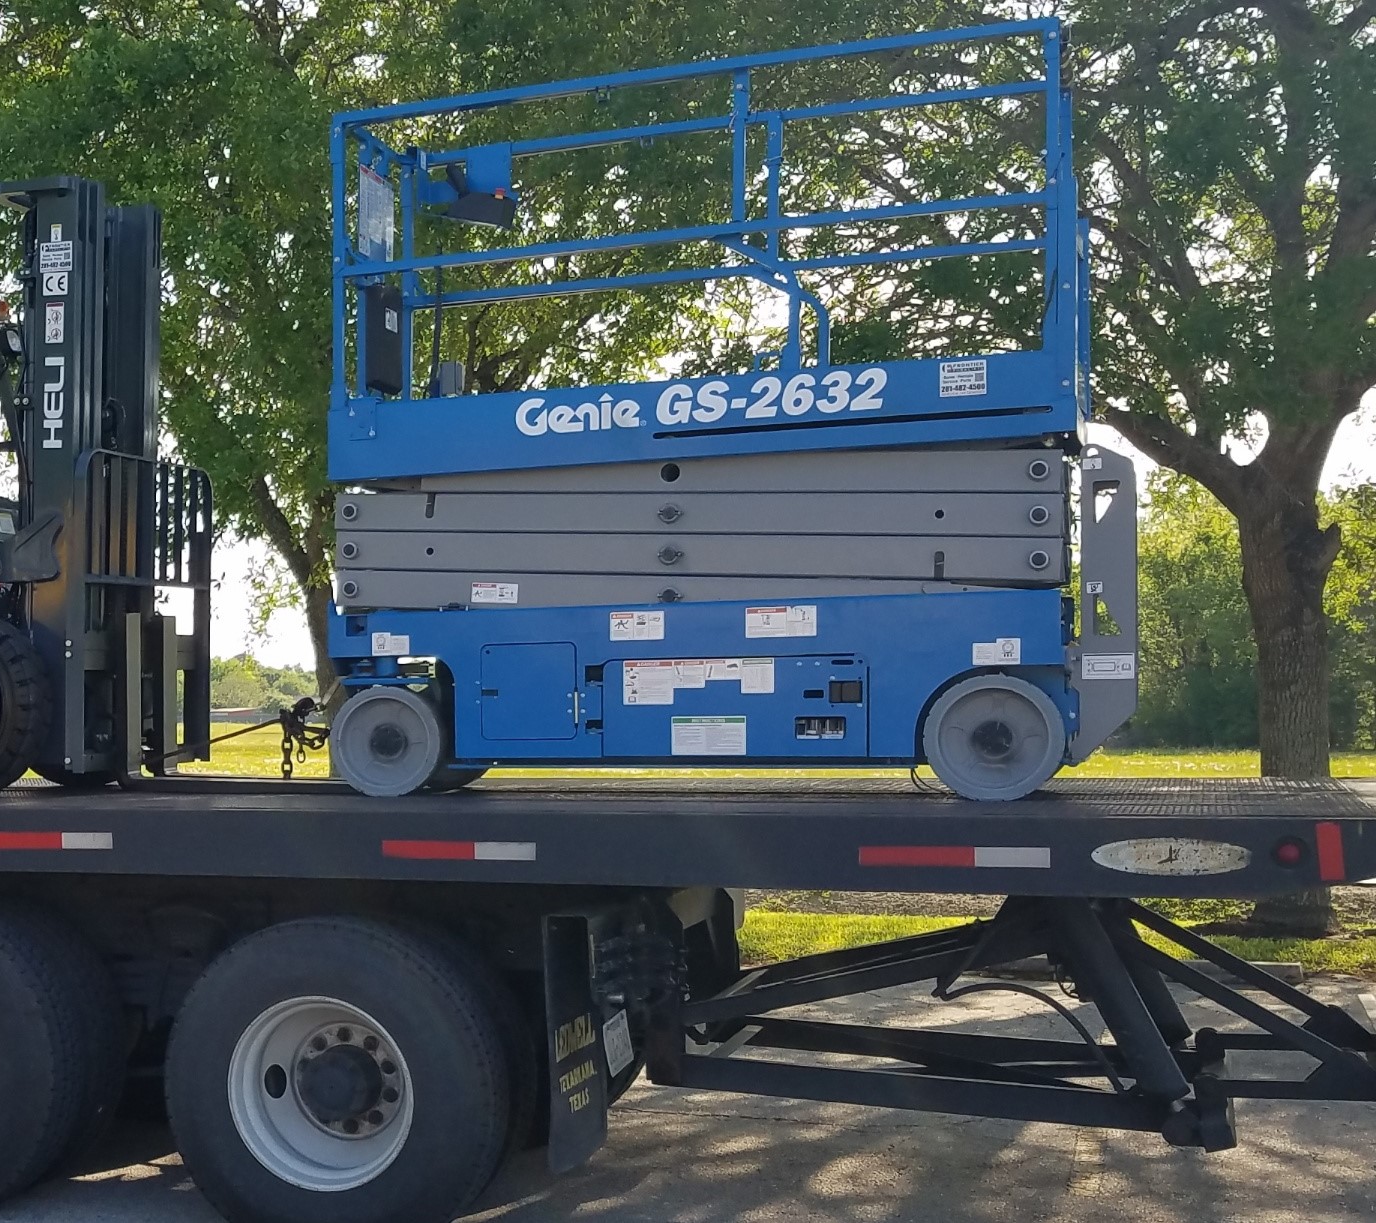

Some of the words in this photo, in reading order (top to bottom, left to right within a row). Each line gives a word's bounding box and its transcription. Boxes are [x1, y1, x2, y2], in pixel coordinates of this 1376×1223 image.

[45, 275, 66, 292] CE
[43, 356, 65, 449] HELI
[515, 393, 641, 436] Genie
[655, 367, 888, 425] GS-2632
[569, 1087, 589, 1114] TEXAS
